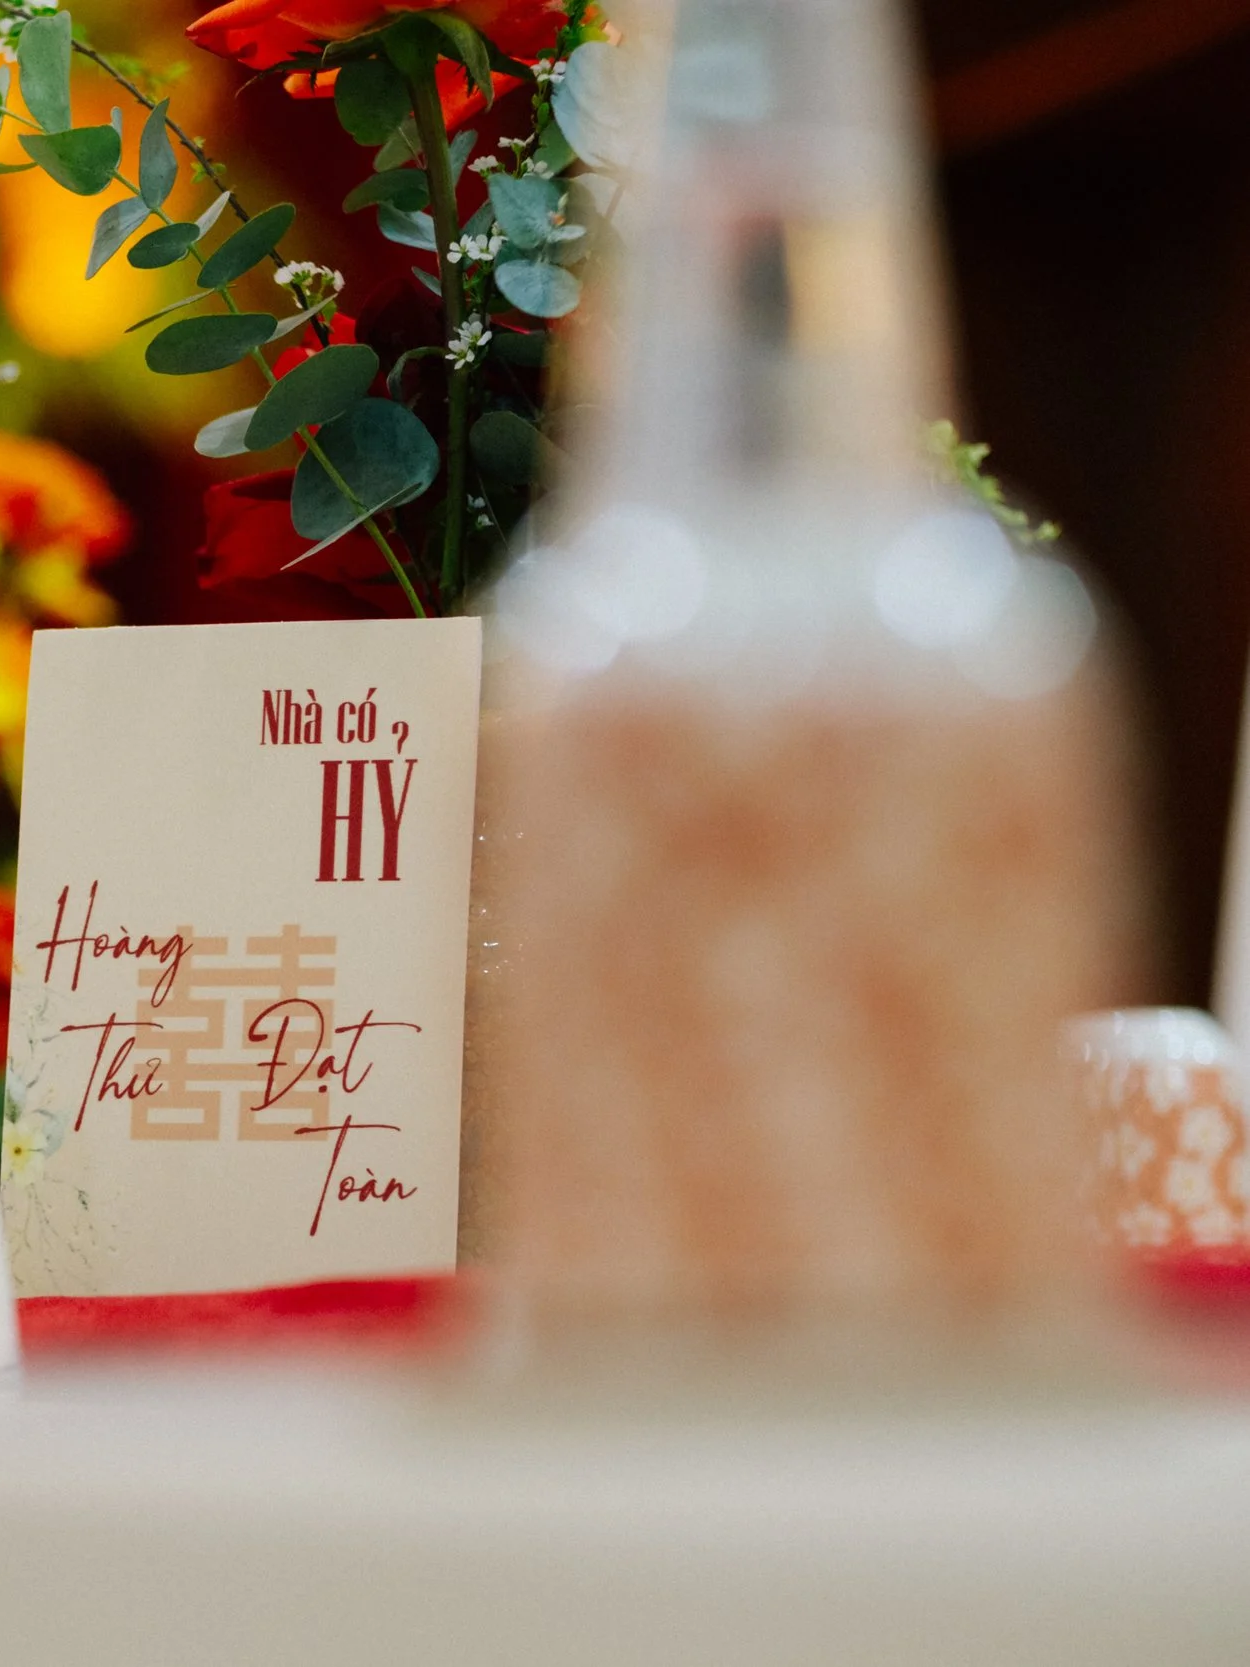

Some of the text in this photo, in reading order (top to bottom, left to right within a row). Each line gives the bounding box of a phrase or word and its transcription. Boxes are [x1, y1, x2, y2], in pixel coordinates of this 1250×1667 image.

[260, 687, 377, 745] Nhà có
[315, 721, 418, 882] HỶ
[36, 879, 194, 1009] Hoàng
[247, 998, 421, 1112] Đạt
[294, 1115, 418, 1237] Toàn
